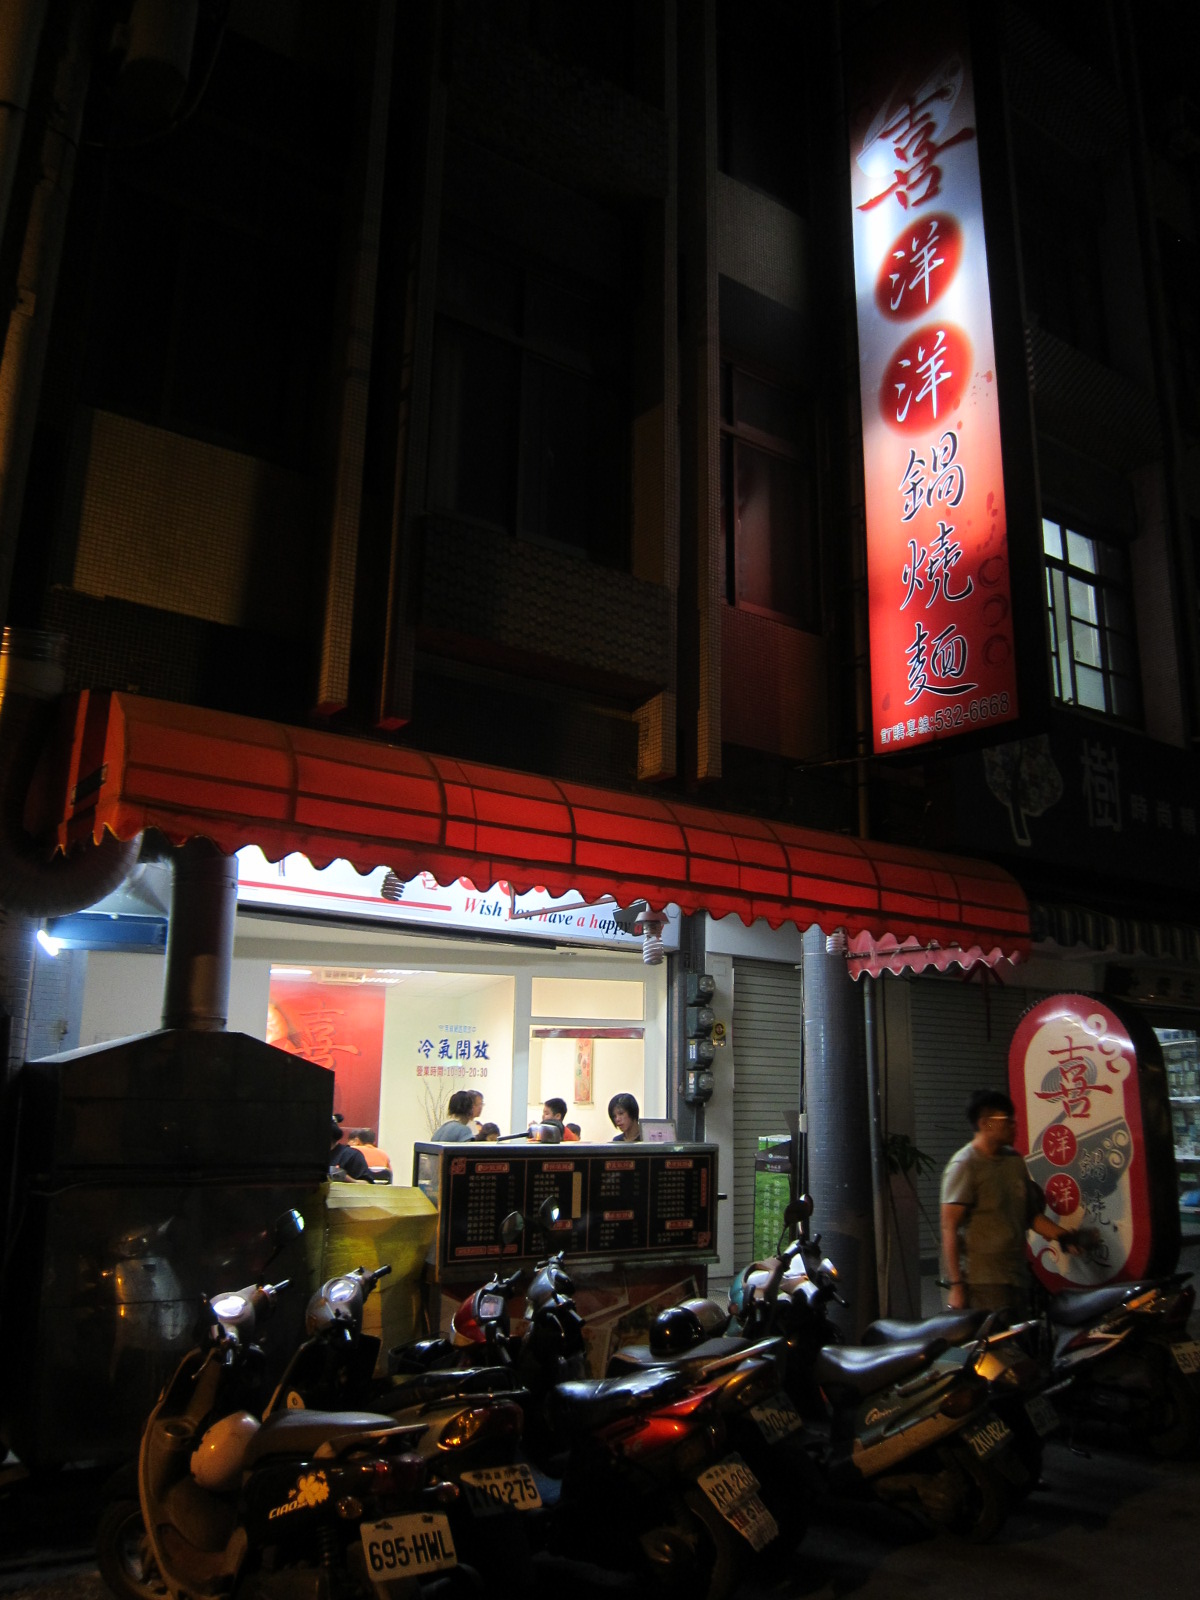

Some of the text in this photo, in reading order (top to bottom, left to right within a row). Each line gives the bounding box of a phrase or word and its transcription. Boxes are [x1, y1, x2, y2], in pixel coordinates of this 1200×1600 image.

[856, 85, 977, 705] 喜洋洋鍋燒麵
[464, 897, 502, 917] Wish
[539, 907, 573, 925] have
[576, 916, 585, 927] a
[589, 913, 631, 935] happy
[417, 1038, 491, 1061] 冷氣開放
[368, 1530, 454, 1572] 695-HWL
